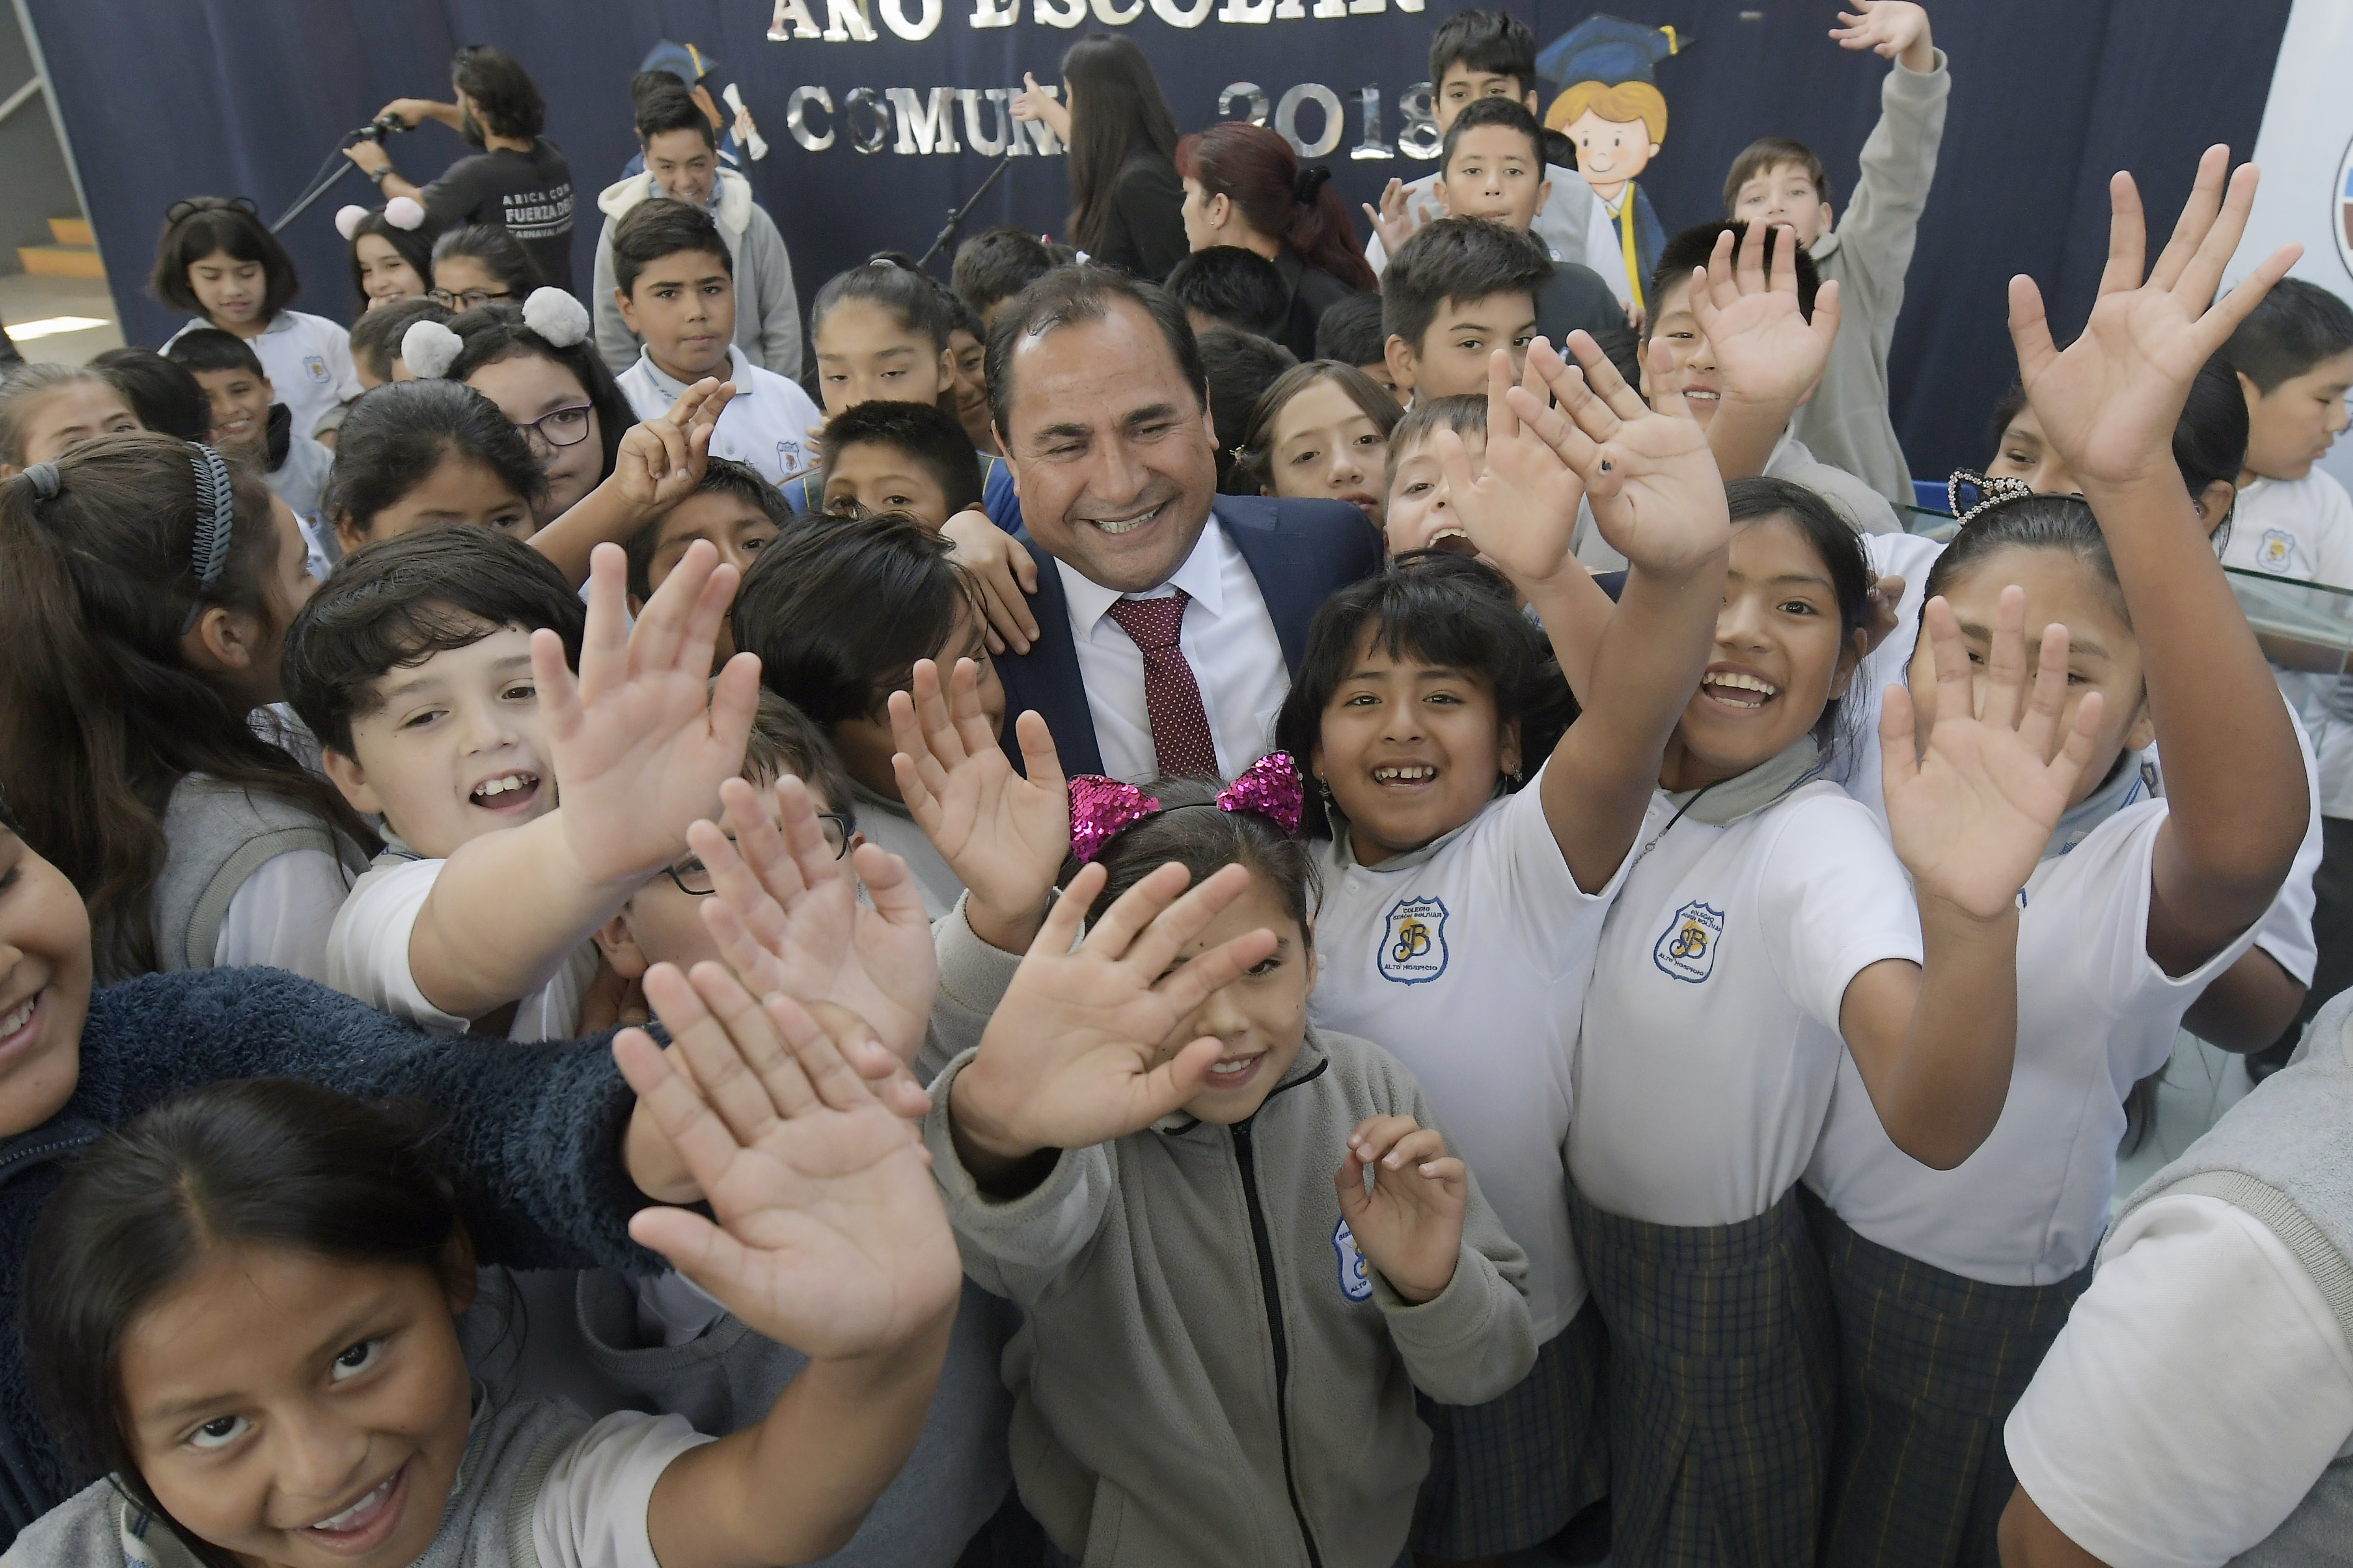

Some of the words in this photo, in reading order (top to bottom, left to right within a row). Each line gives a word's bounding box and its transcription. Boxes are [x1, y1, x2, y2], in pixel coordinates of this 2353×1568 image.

[1218, 81, 1443, 160] 2018
[503, 192, 546, 205] ARICA
[505, 204, 557, 222] FUERZA
[1658, 952, 1673, 962] ALTO
[1350, 1281, 1367, 1293] ALTO
